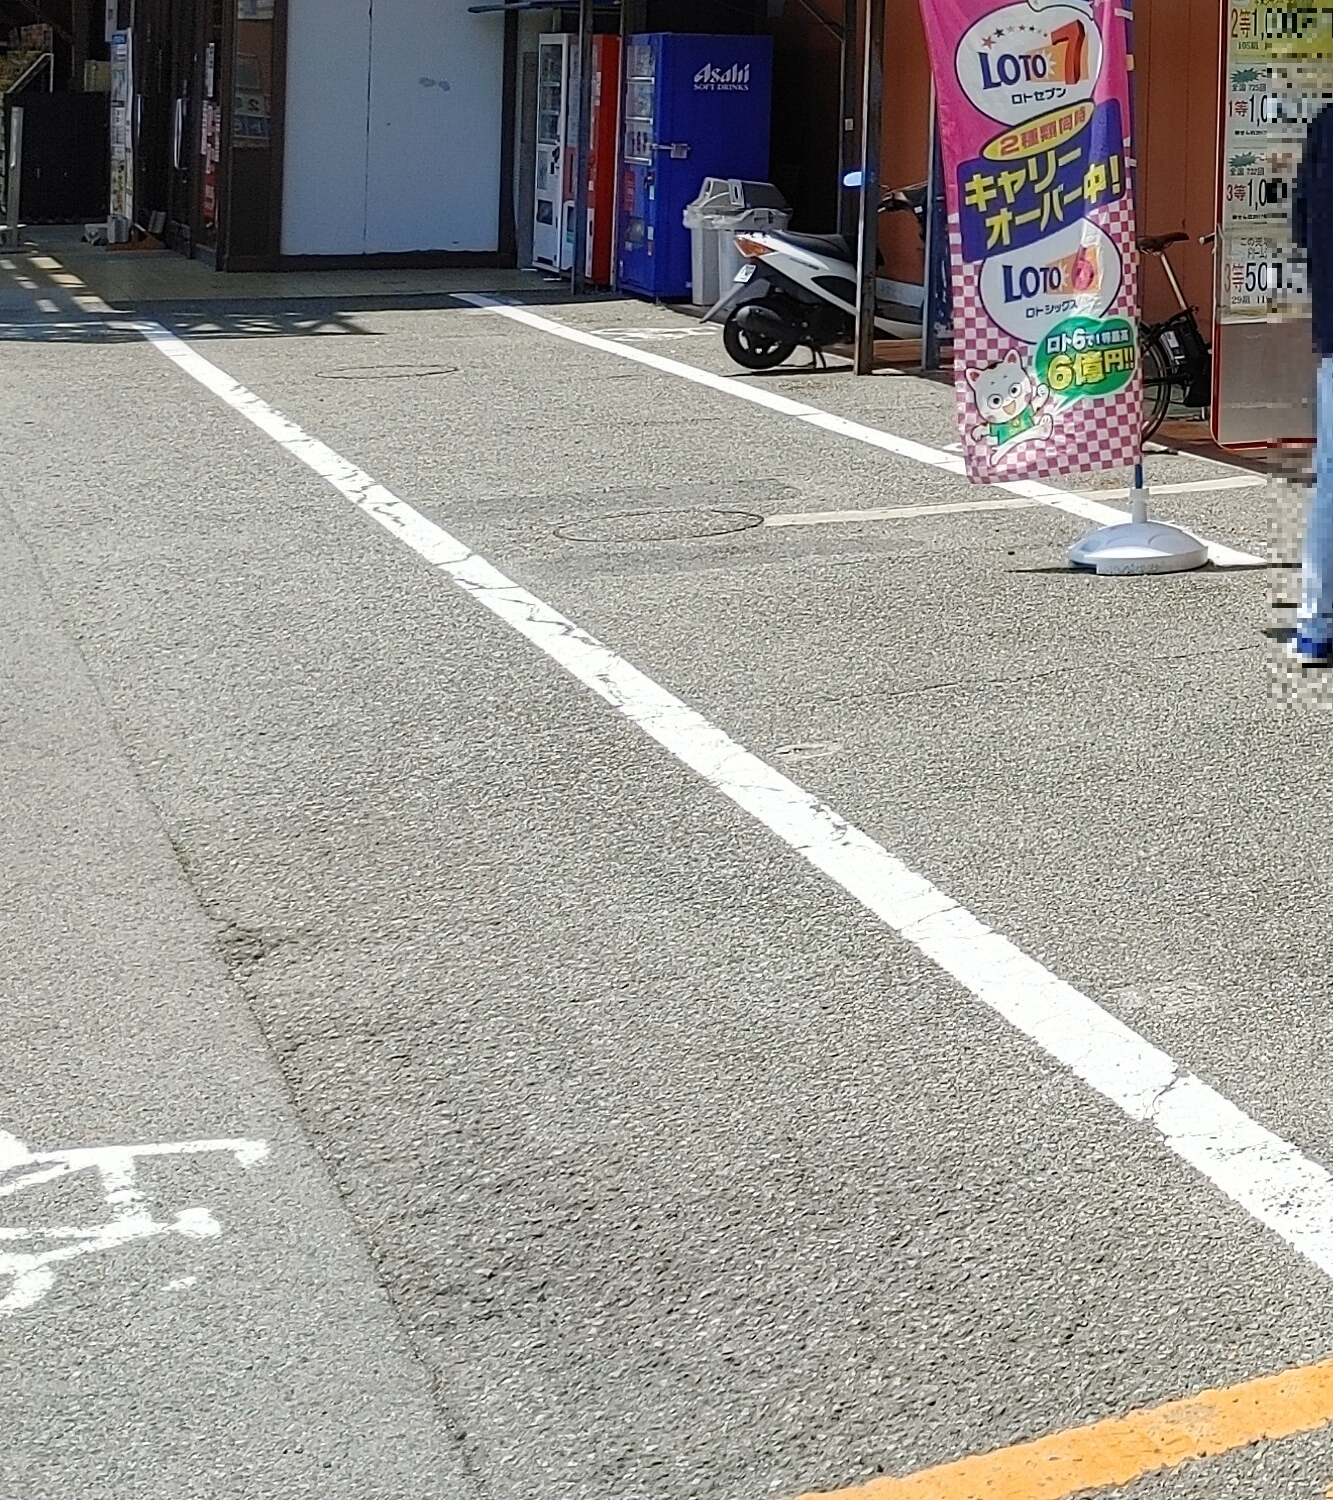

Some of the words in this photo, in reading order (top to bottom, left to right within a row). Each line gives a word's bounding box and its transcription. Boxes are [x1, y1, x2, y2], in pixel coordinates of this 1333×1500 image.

[693, 62, 750, 83] Asahi
[977, 51, 1047, 92] LOTO
[1049, 19, 1088, 88] 7
[693, 83, 715, 91] SOFT
[717, 84, 750, 92] DRINKS
[1010, 86, 1067, 106] ロトセブン
[964, 146, 1083, 214] キャリー
[986, 155, 1123, 250] オーバー中!
[1002, 265, 1062, 304] LOTO
[1026, 298, 1079, 319] ロトシックス
[1047, 346, 1135, 390] 6億円!!
